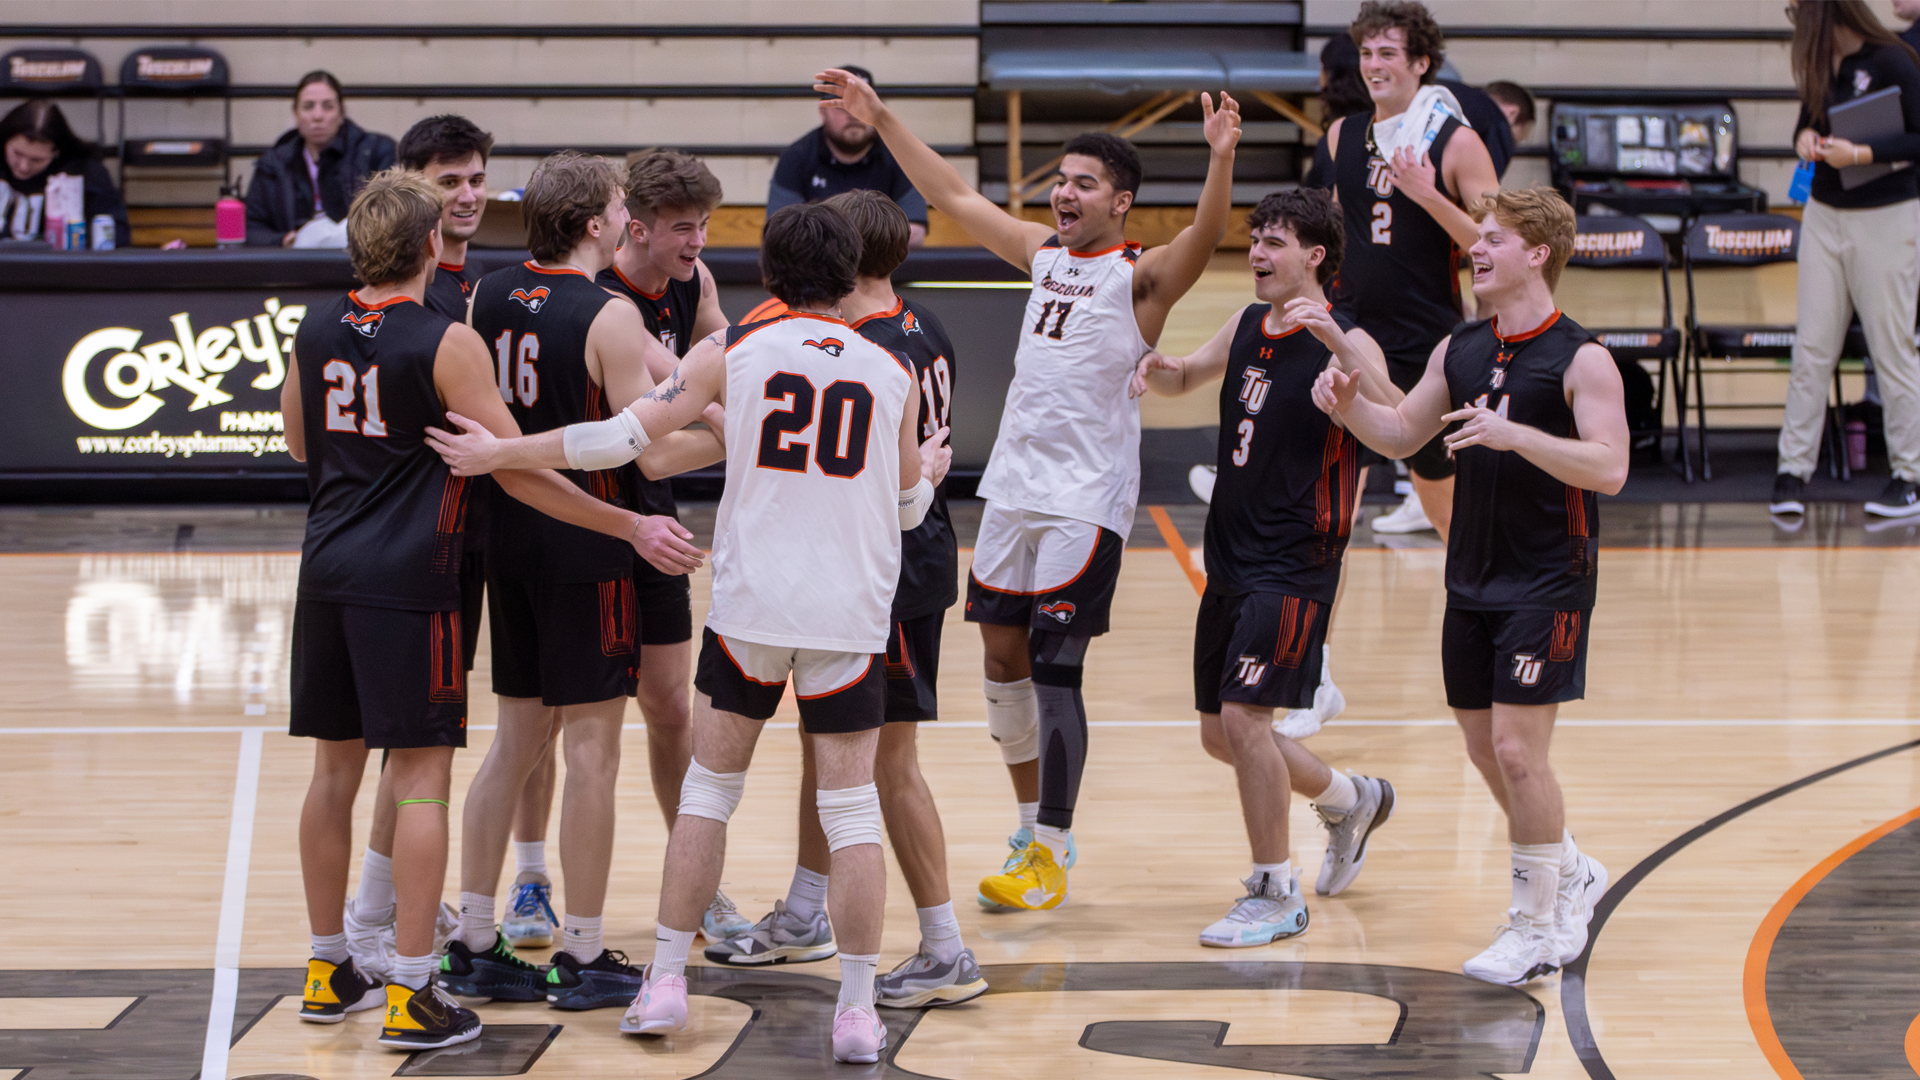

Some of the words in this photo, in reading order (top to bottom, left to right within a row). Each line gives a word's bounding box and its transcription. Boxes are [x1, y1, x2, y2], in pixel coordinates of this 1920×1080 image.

[1366, 156, 1395, 198] TU
[1371, 201, 1393, 246] 2
[1704, 225, 1793, 249] TUSCULUM
[1033, 299, 1075, 341] 17
[495, 328, 540, 409] 16
[1238, 365, 1272, 415] TU
[1488, 366, 1508, 391] TU
[322, 357, 389, 438] 21
[756, 370, 875, 480] 20
[1231, 418, 1255, 468] 3
[1235, 654, 1268, 688] TU
[1510, 652, 1545, 688] TU
